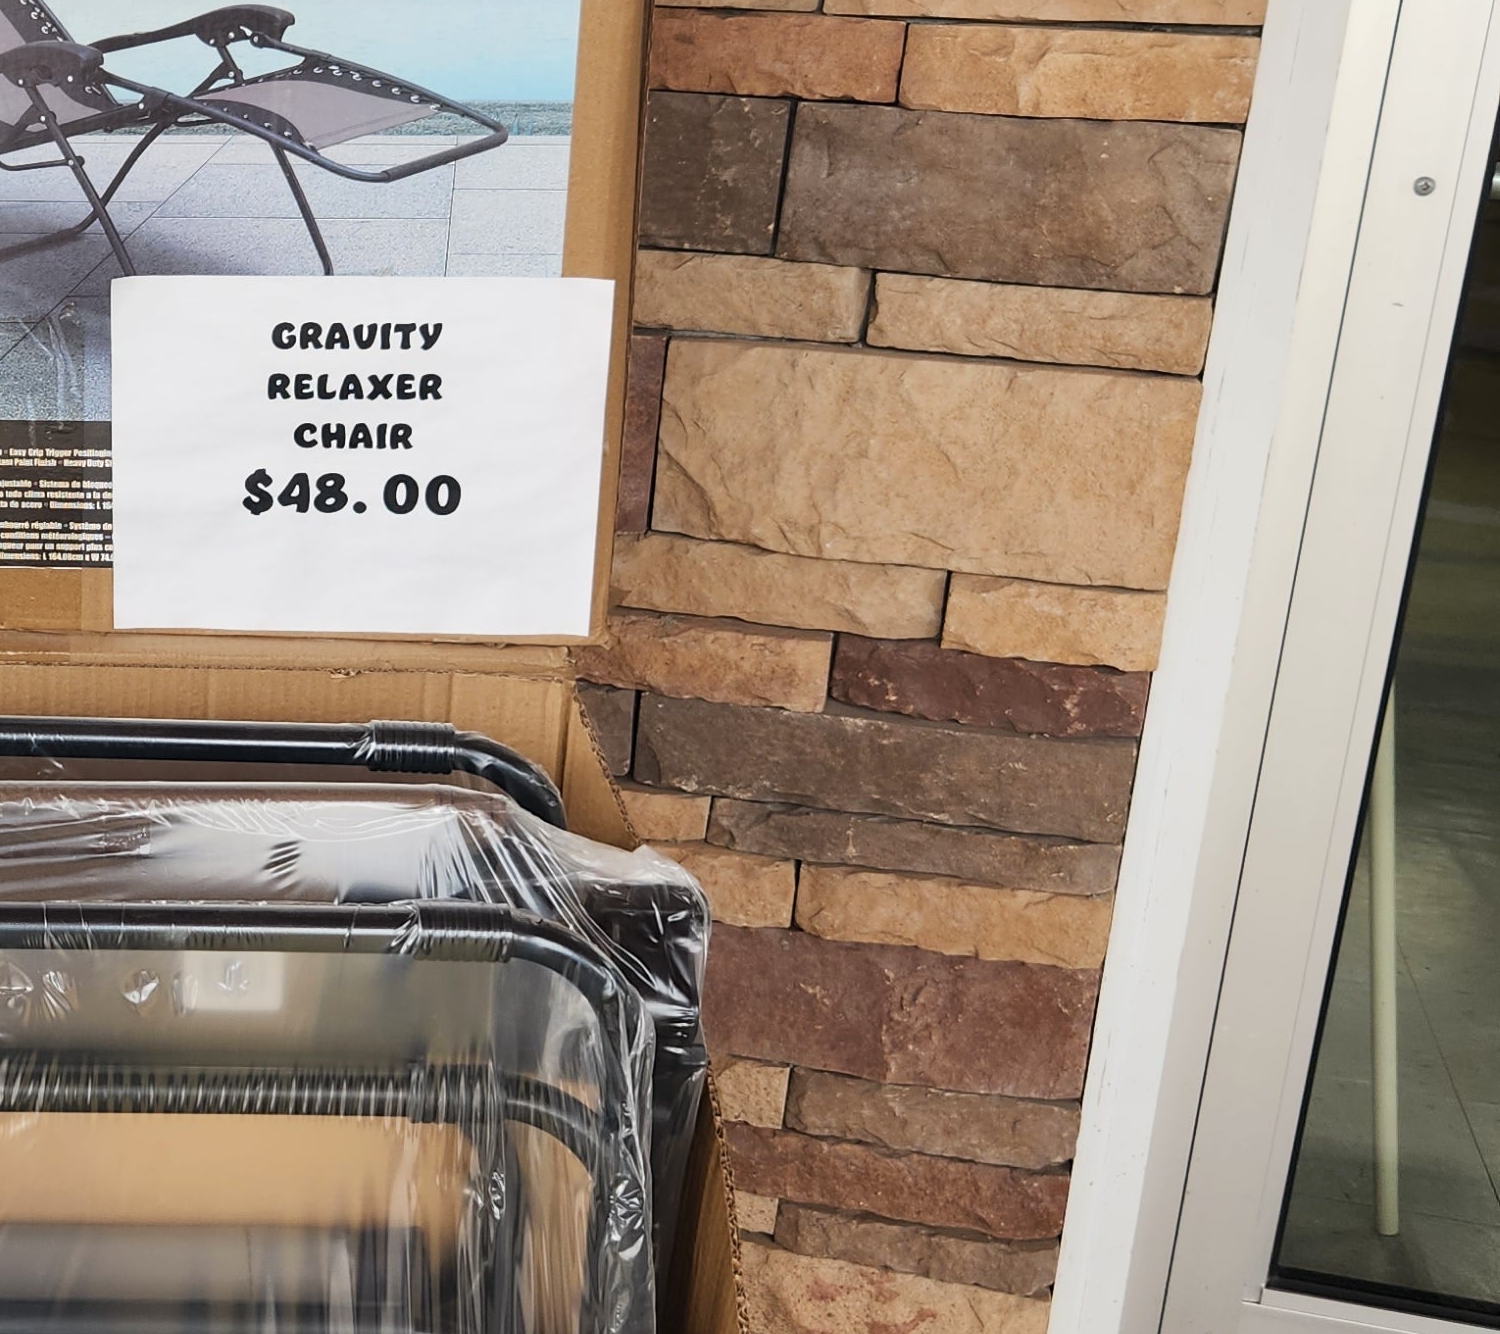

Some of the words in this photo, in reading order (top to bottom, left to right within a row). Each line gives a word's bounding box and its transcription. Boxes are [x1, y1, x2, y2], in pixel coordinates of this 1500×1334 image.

[271, 322, 443, 351] GRAVITY
[267, 373, 443, 401] RELAXER
[294, 423, 413, 450] CHAIR
